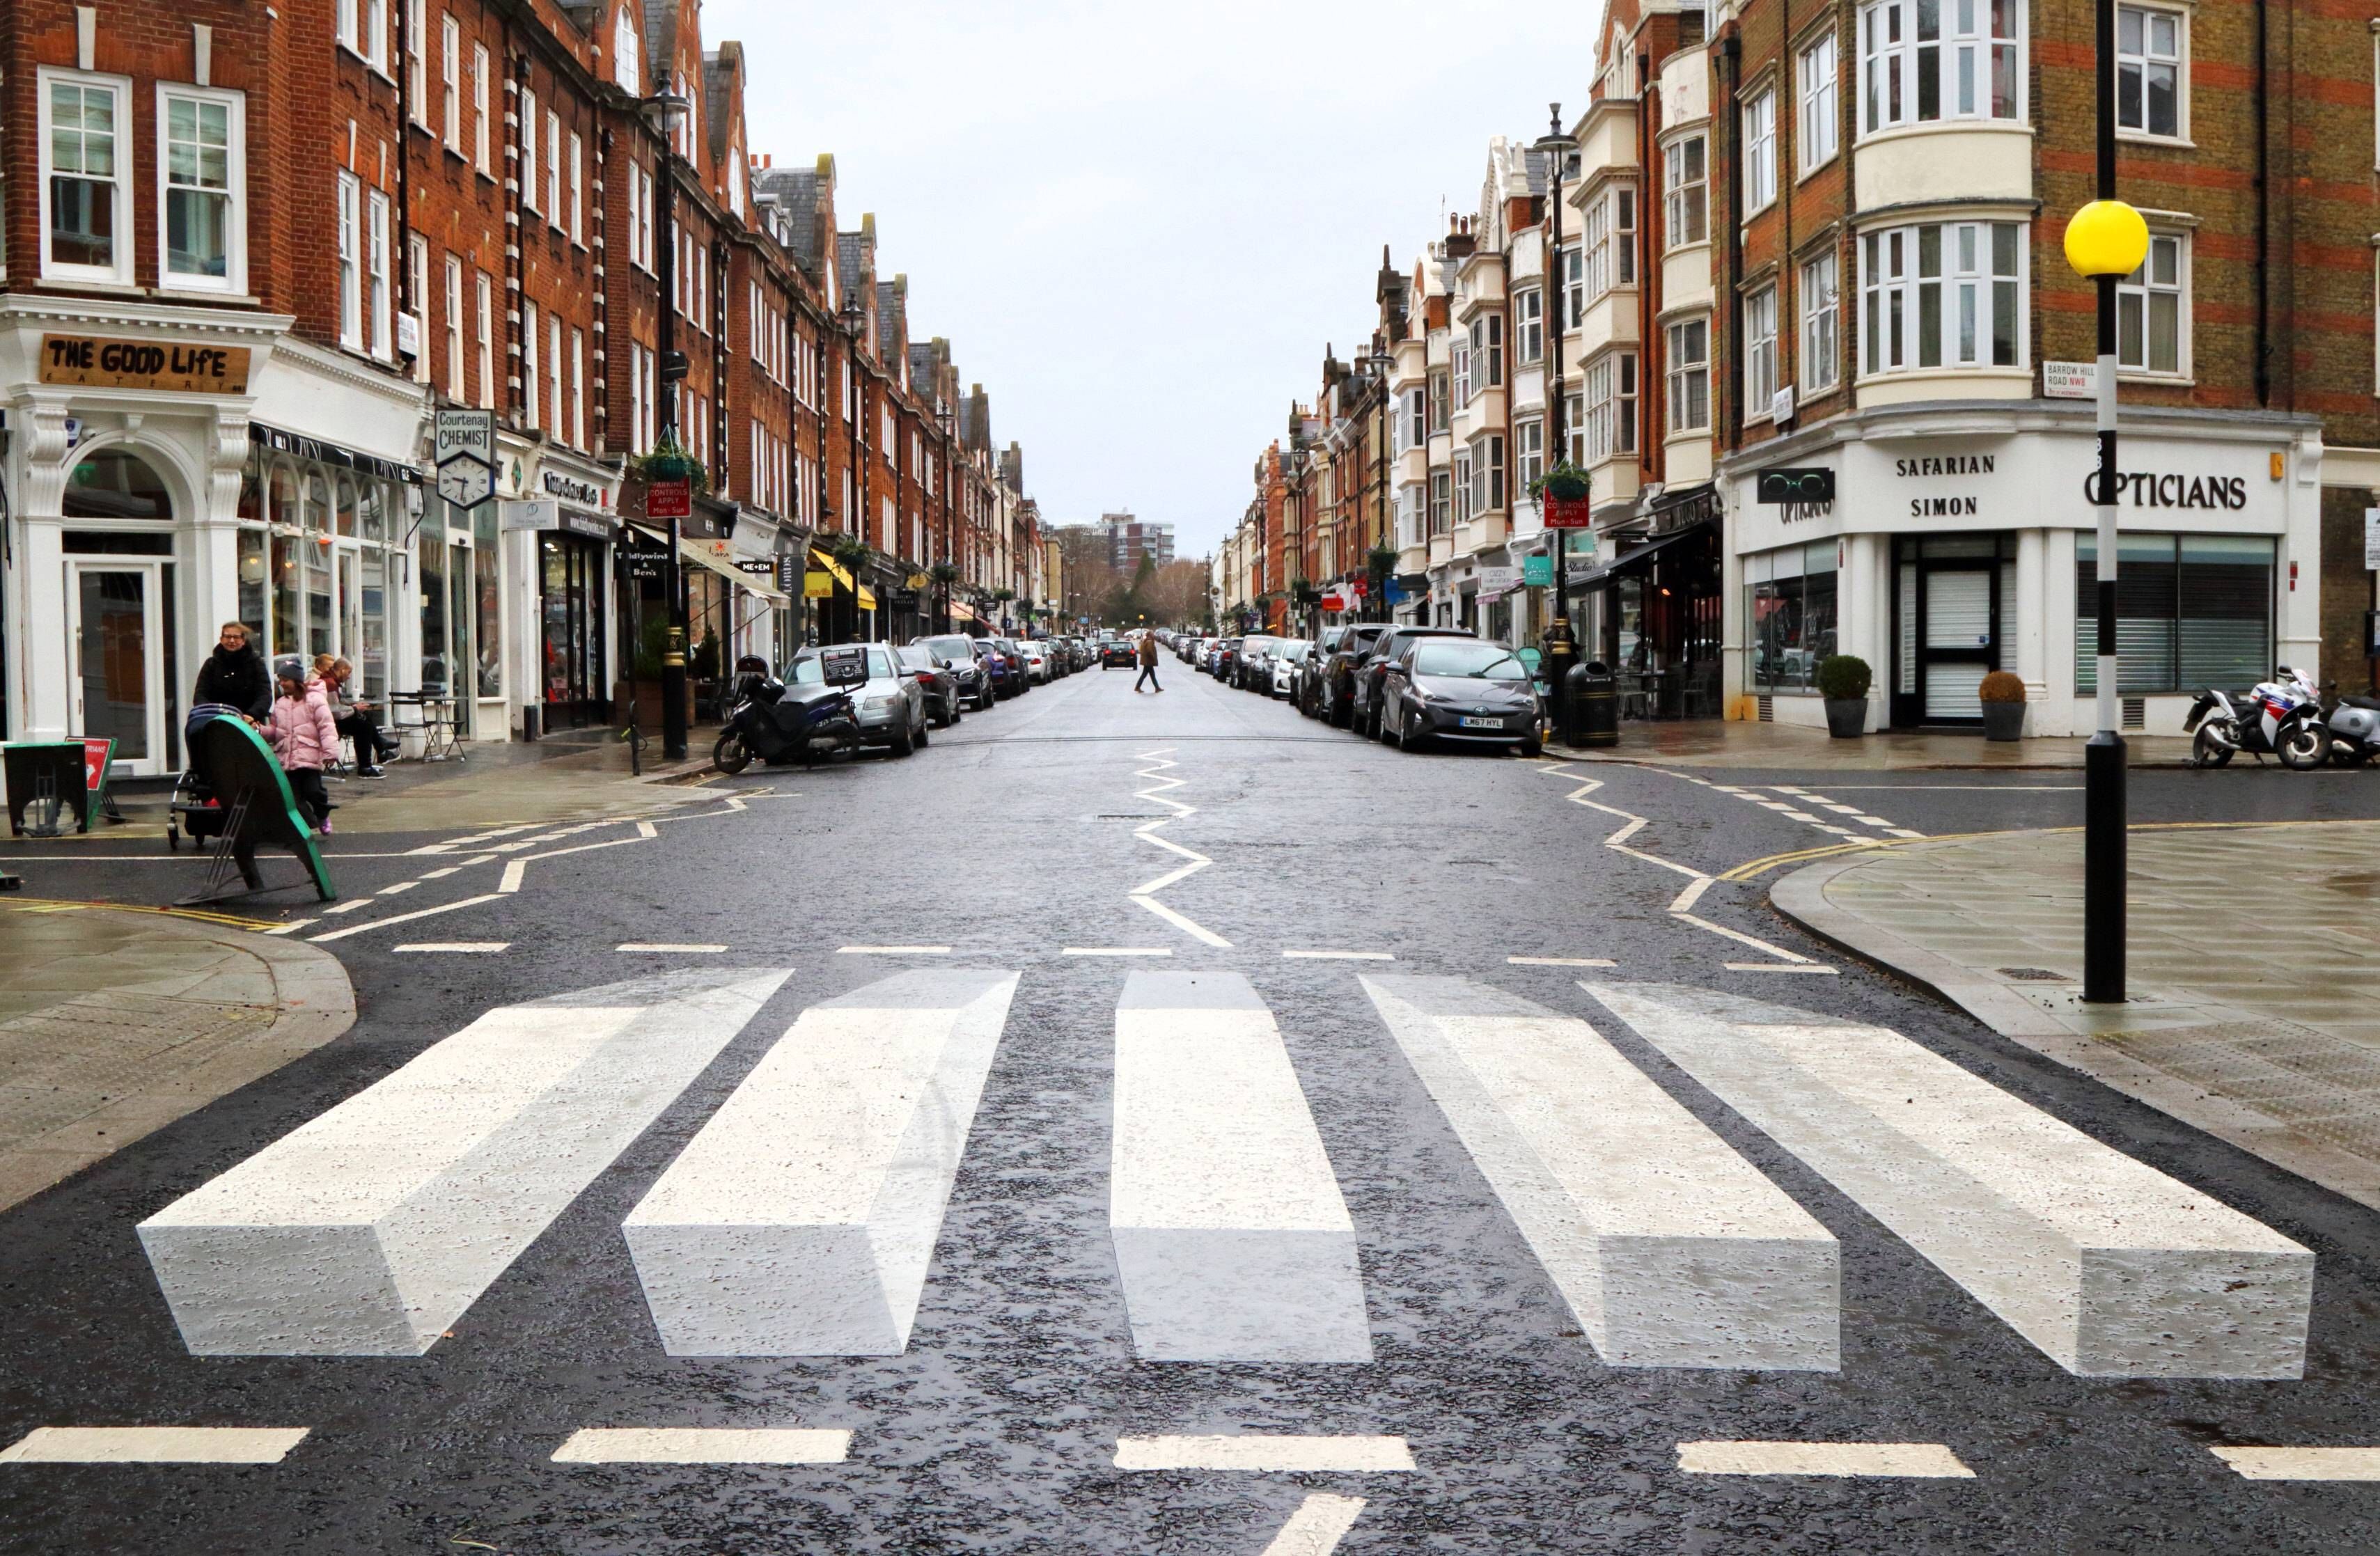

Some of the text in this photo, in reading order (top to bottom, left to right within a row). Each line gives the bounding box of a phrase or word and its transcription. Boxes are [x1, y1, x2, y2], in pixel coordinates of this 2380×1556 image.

[49, 339, 94, 369] THE
[100, 343, 165, 375] GOOD
[2048, 365, 2095, 376] BARROW HILL
[2048, 376, 2085, 386] ROAD NW8
[439, 412, 488, 428] Courtenay
[439, 430, 489, 450] CHEMIST
[1896, 455, 1995, 477] SAFARIAN
[1911, 496, 1977, 517] SIMON
[633, 567, 657, 576] Ben's
[783, 556, 792, 592] LORDS
[808, 588, 831, 596] savills
[1487, 718, 1501, 727] HYL
